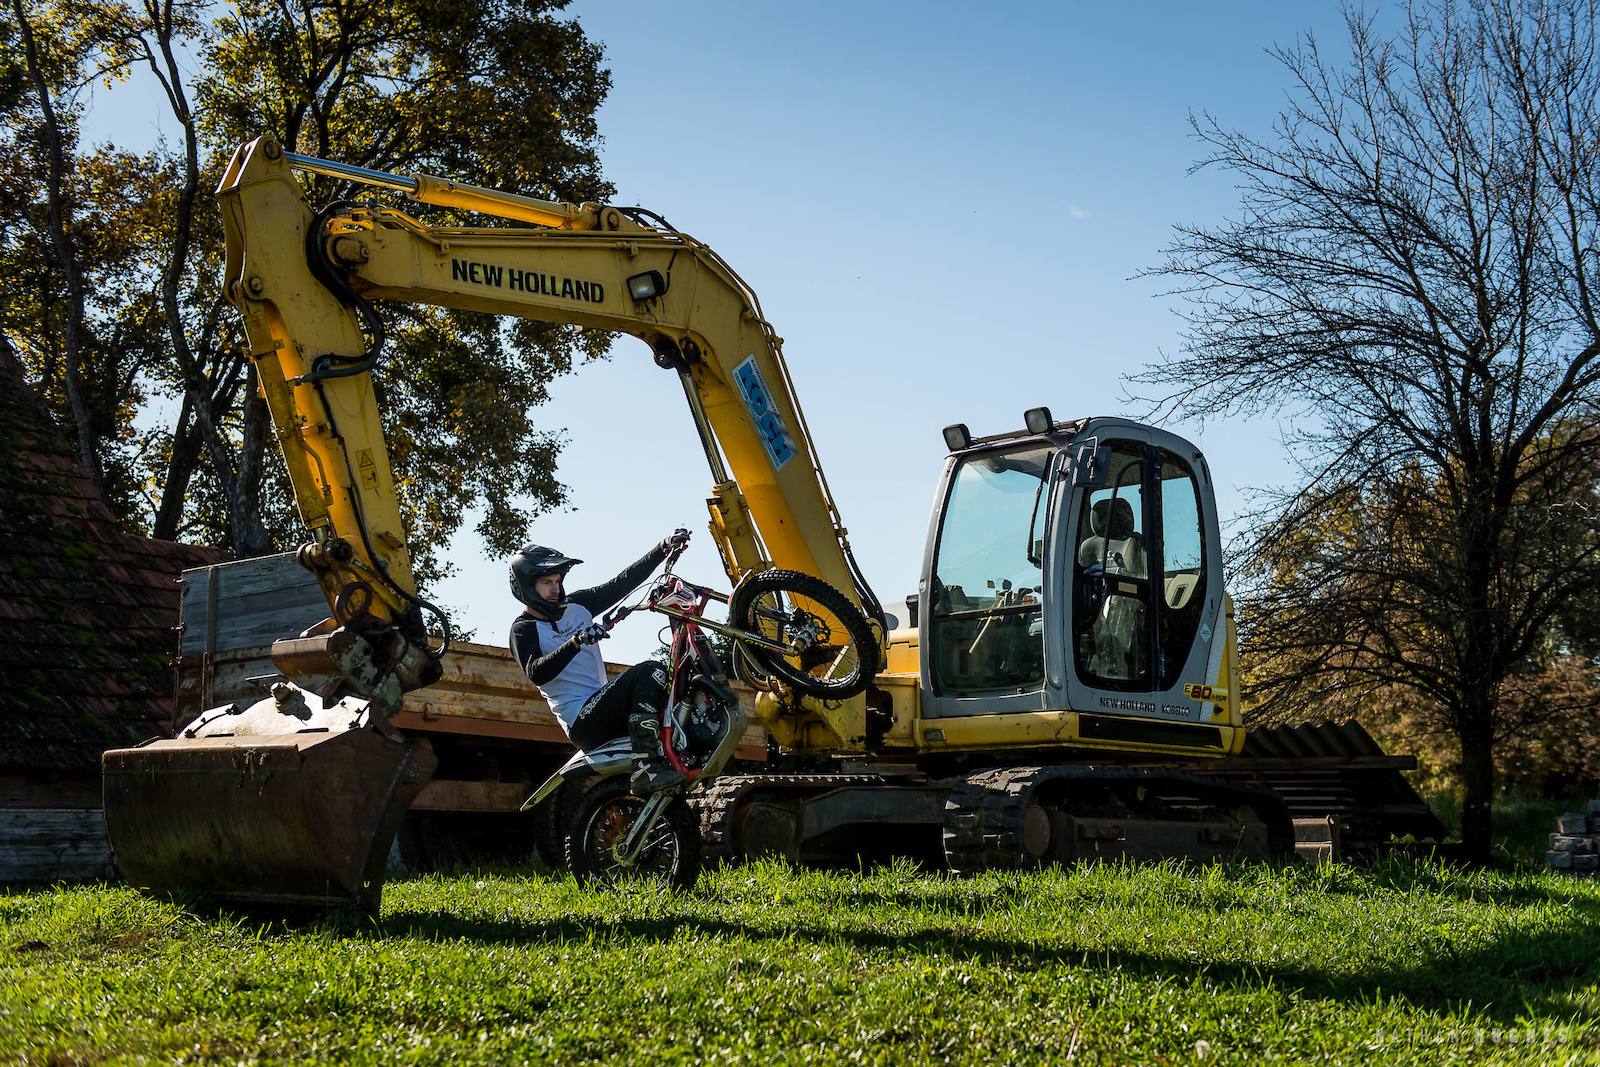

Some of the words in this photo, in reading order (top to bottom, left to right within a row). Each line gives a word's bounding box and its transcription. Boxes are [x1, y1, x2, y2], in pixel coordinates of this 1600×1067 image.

[452, 258, 503, 288] NEW
[508, 268, 604, 304] HOLLAND
[738, 361, 792, 465] KOCH
[1100, 697, 1118, 709] NEW
[1120, 700, 1156, 713] HOLLAND
[1161, 704, 1190, 716] KOBELCO
